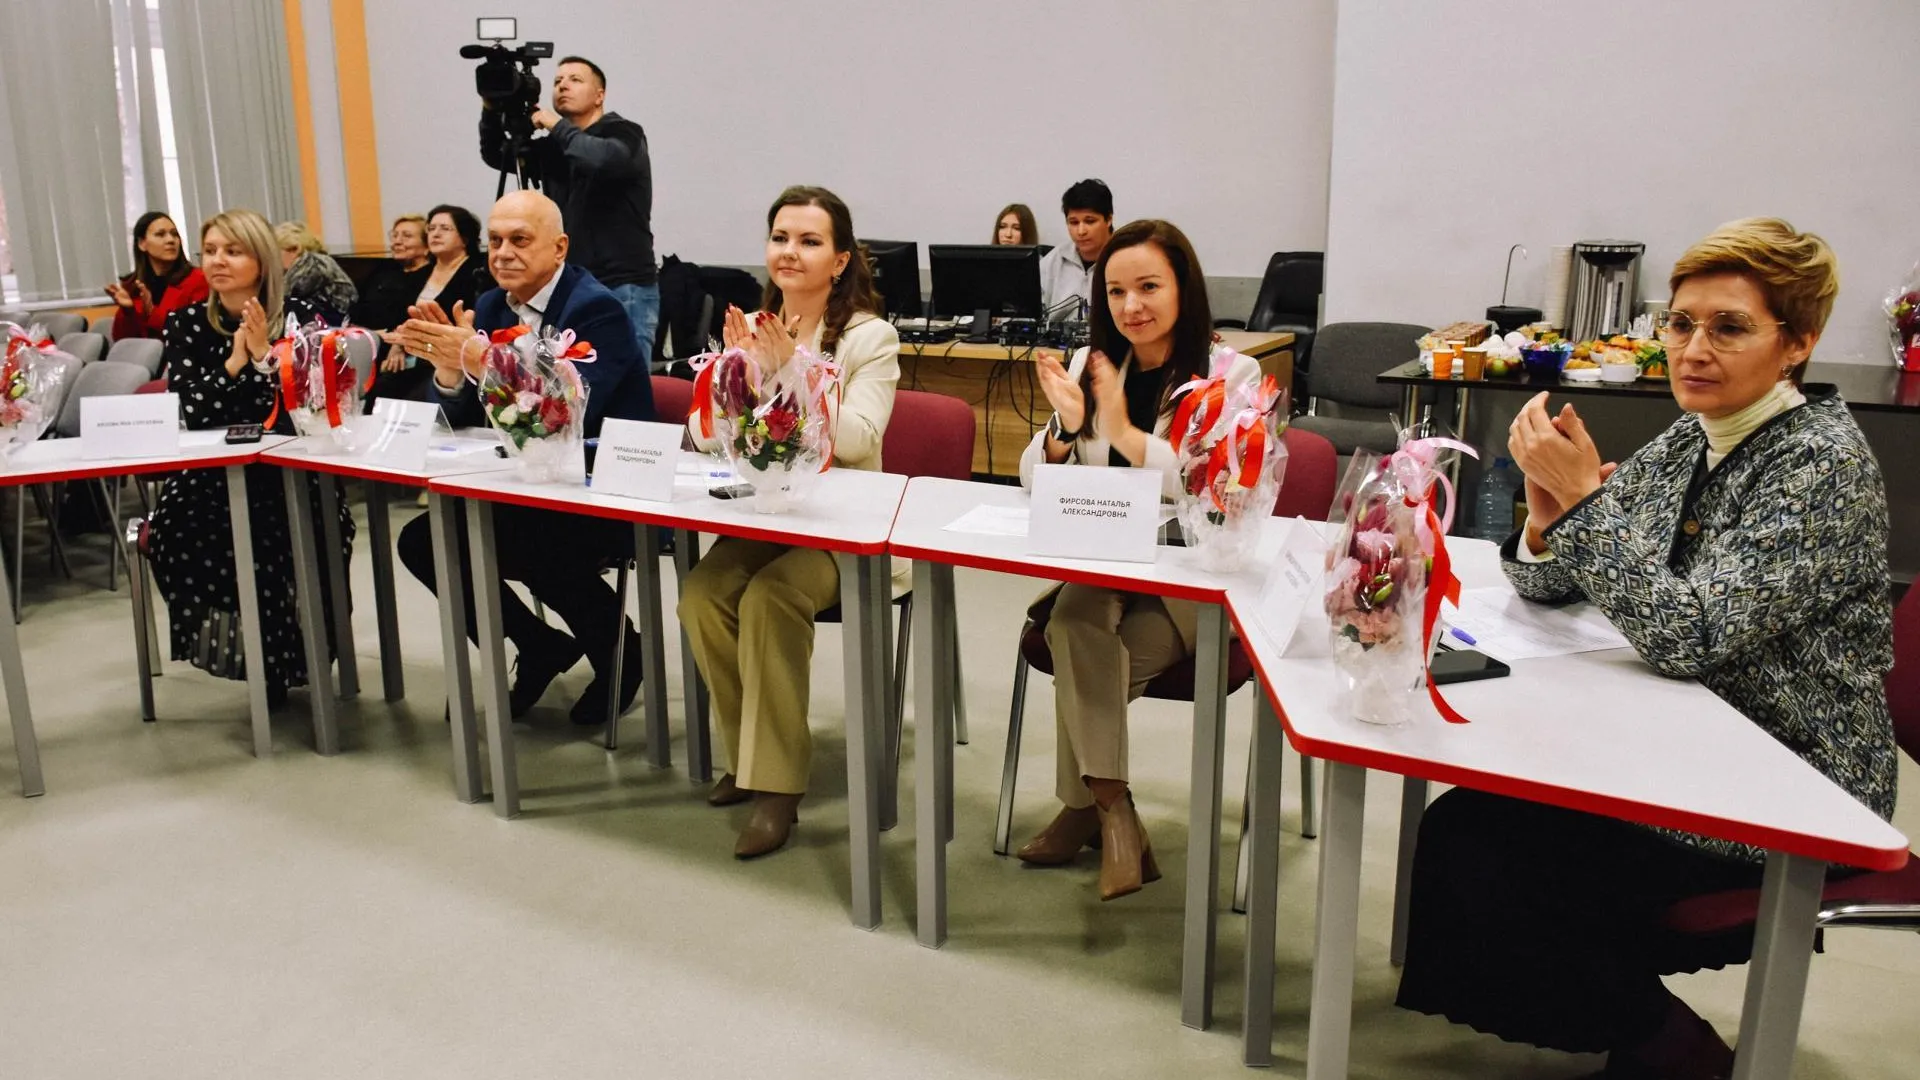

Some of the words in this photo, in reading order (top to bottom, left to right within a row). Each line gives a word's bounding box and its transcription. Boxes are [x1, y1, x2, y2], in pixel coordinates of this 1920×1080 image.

[1060, 497, 1095, 506] ФИРСОВА
[1097, 499, 1130, 508] НАТАЛЬЯ
[1062, 508, 1127, 518] АЛЕКСАНДРОВНА
